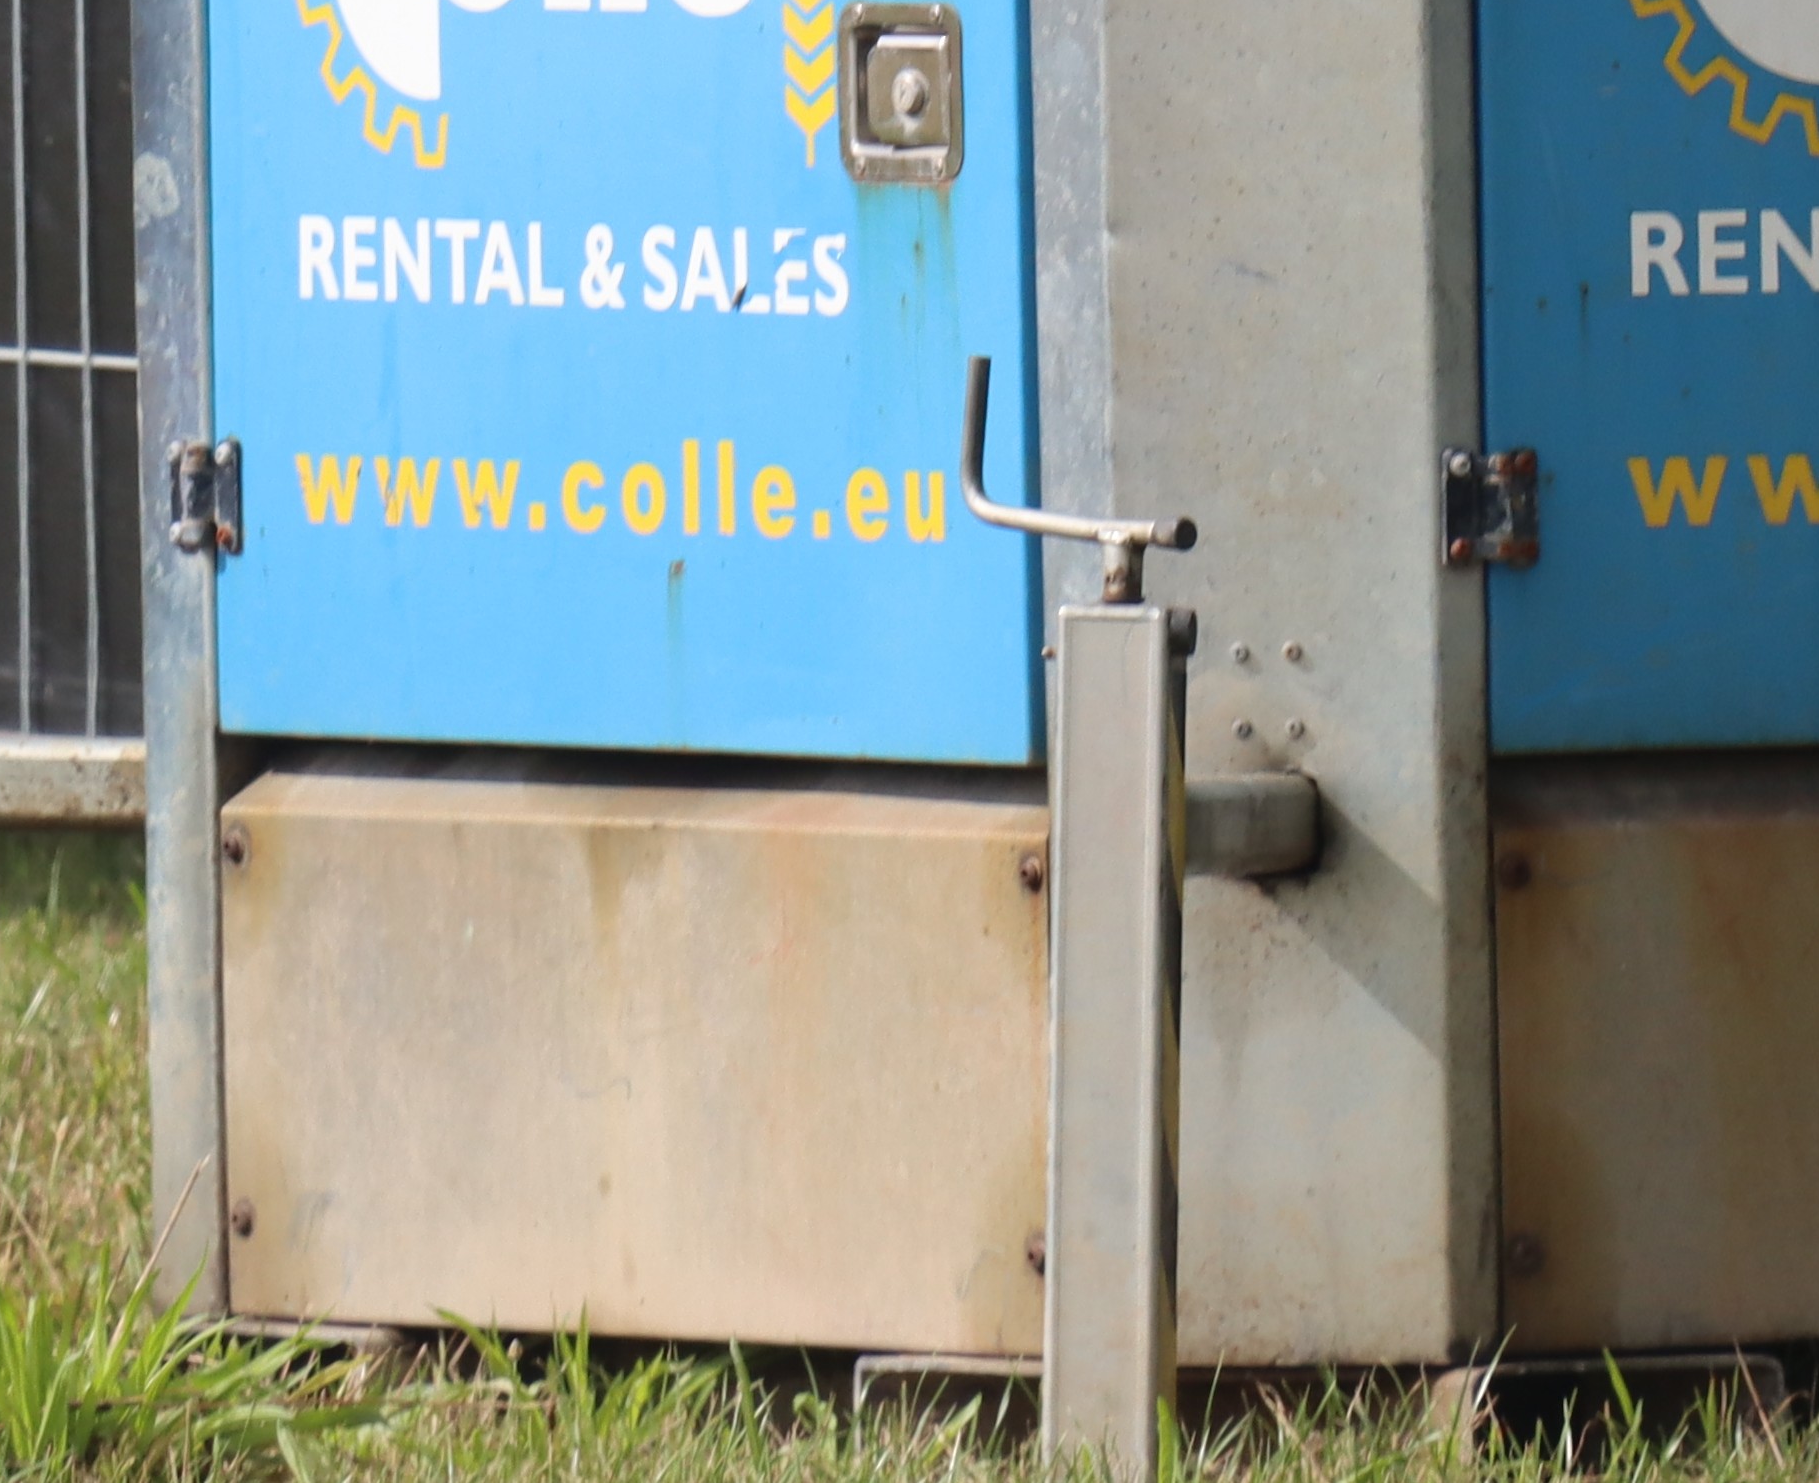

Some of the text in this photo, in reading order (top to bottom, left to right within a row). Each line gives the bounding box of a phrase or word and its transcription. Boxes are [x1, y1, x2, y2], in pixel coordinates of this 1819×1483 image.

[298, 215, 849, 316] RENTAL & SALES
[295, 438, 948, 542] www.colle.eu
